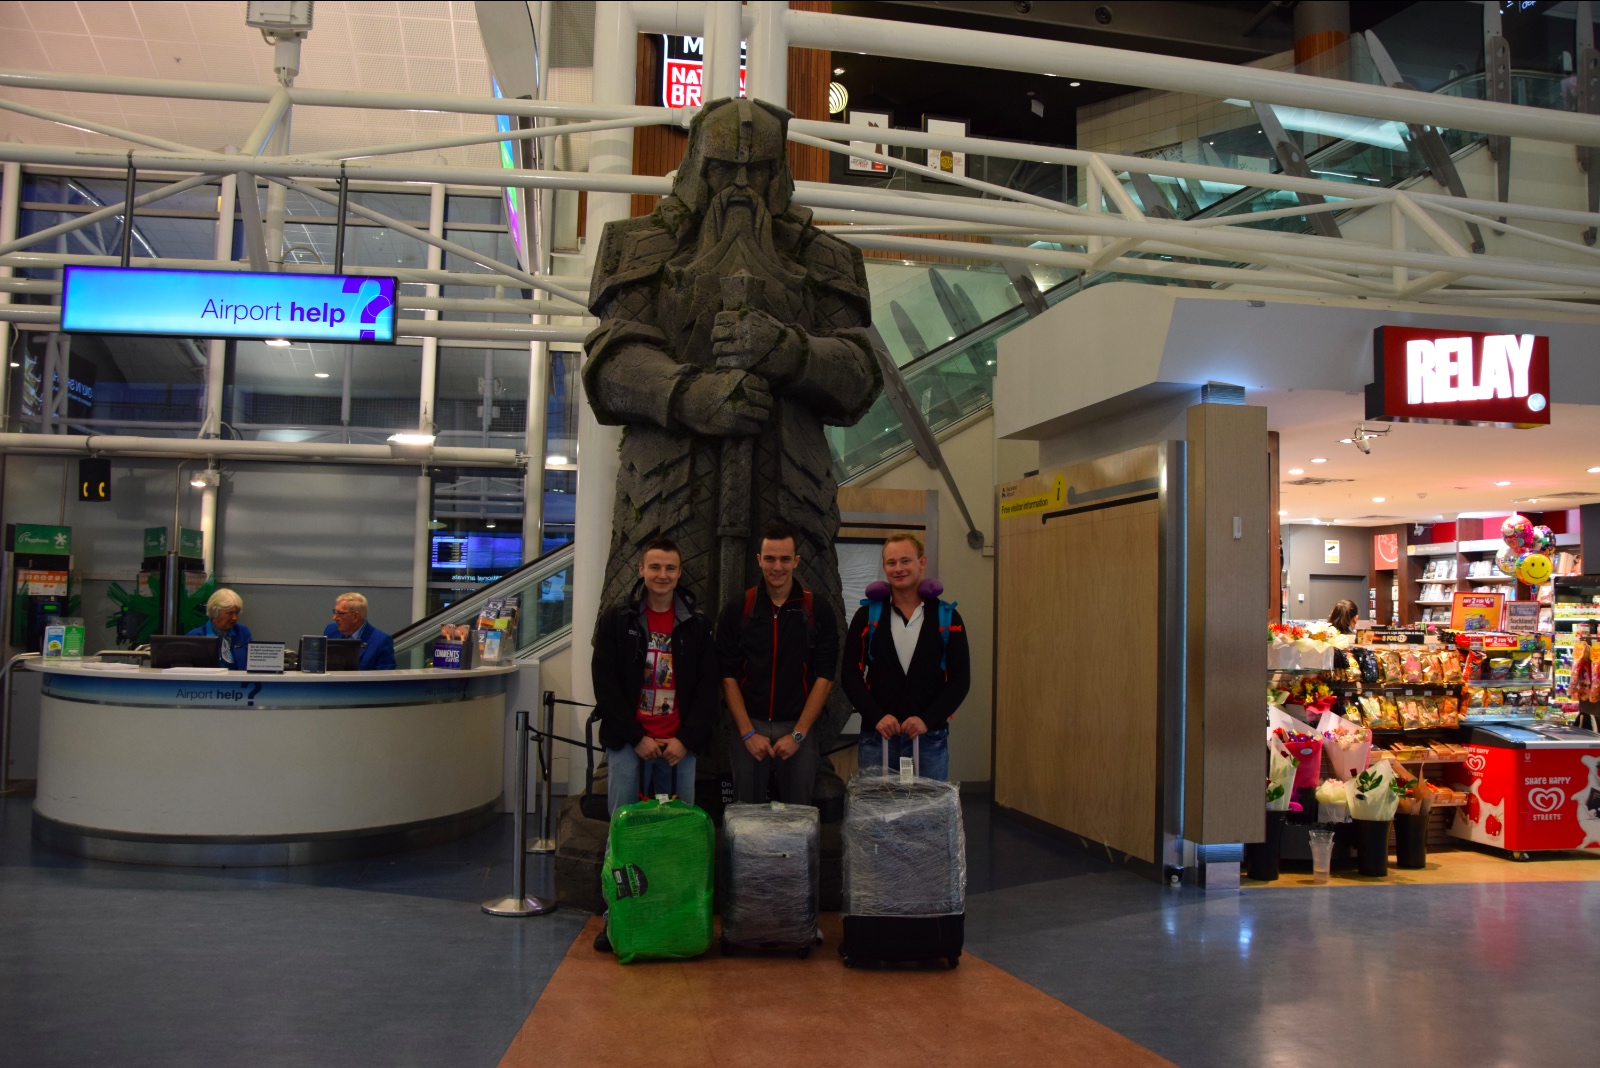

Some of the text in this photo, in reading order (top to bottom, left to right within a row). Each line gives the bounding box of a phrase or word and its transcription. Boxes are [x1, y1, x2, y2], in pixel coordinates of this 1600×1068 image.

[200, 298, 282, 325] Airport
[290, 301, 346, 328] help
[1001, 498, 1048, 514] Free visitor information
[1493, 636, 1498, 644] 2
[176, 688, 214, 701] Airport
[216, 689, 243, 701] help
[1532, 813, 1561, 821] STREETS
